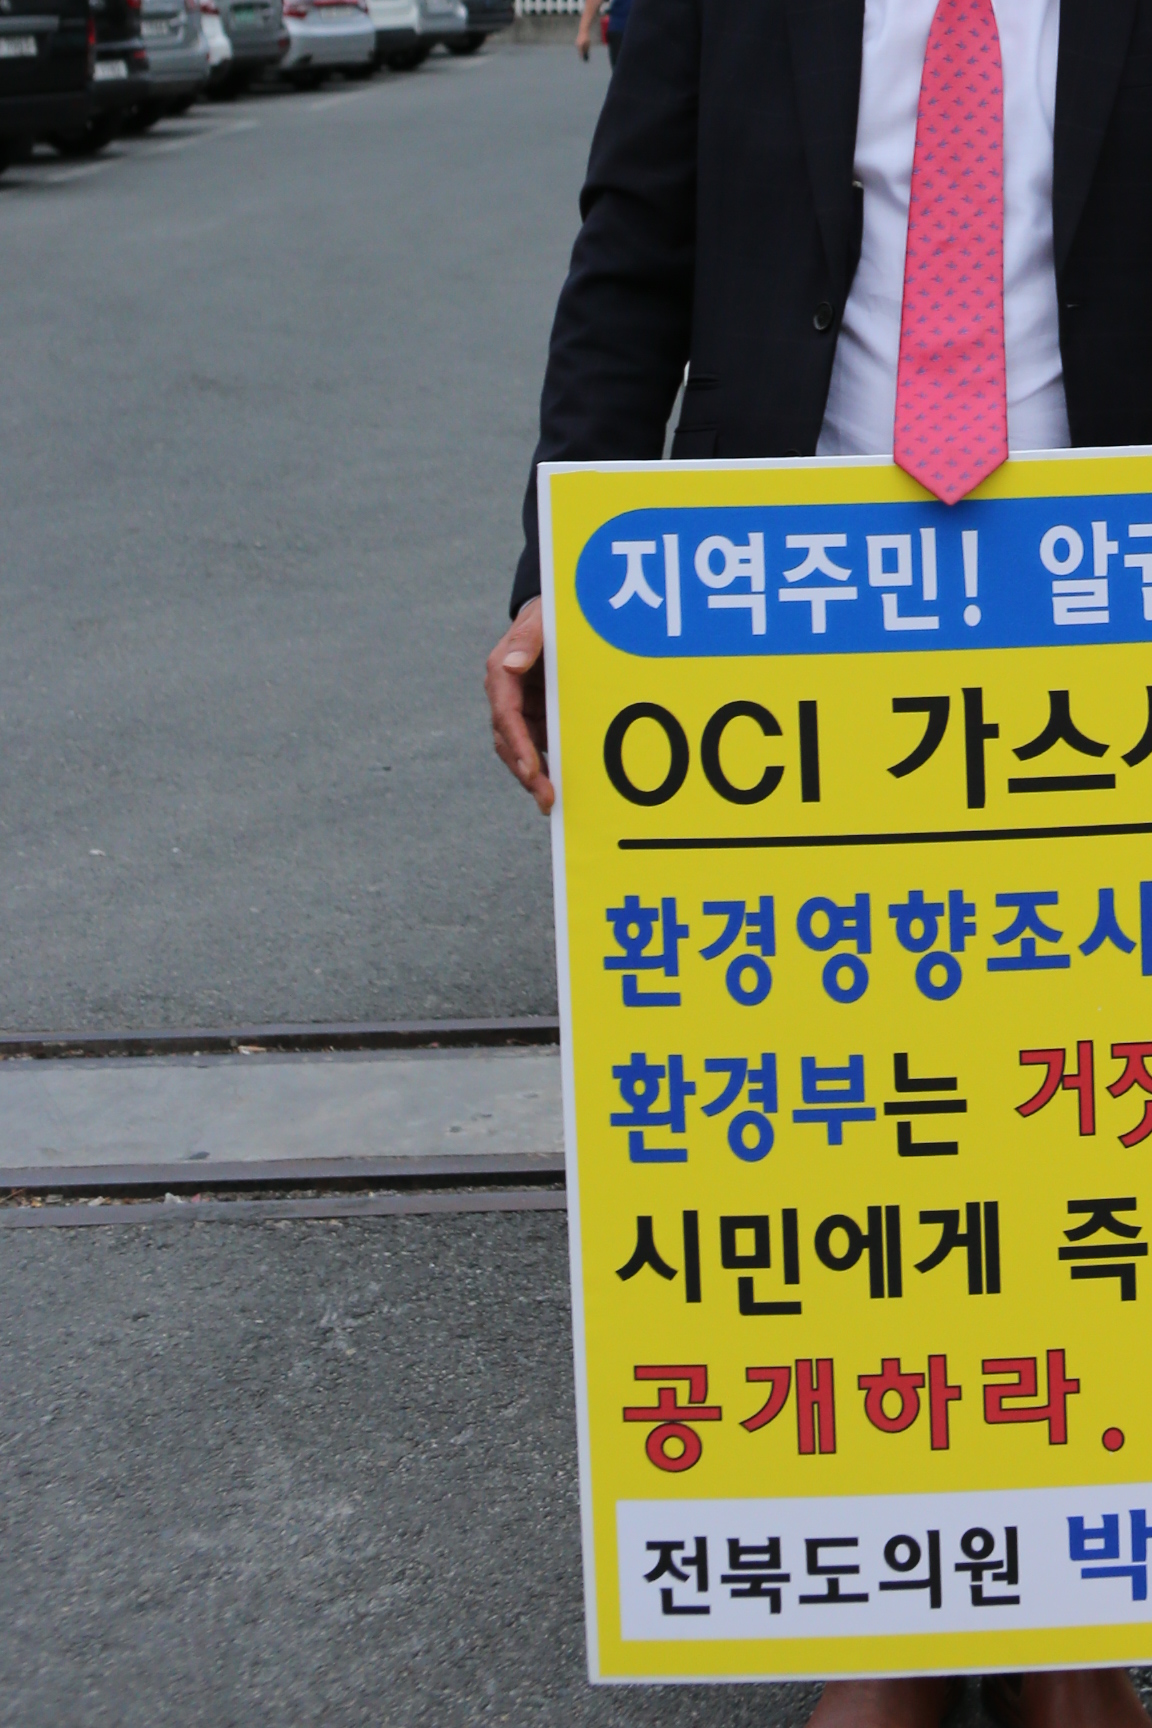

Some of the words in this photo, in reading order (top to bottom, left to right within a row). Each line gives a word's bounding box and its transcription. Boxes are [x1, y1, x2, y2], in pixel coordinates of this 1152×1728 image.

[610, 528, 980, 635] 지역주민!
[603, 700, 820, 807] OCI
[610, 1052, 967, 1163] 환경부는
[615, 1201, 1001, 1316] 시민에게
[622, 1349, 1125, 1473] 공개하라.
[645, 1527, 1020, 1615] 전북도의원
